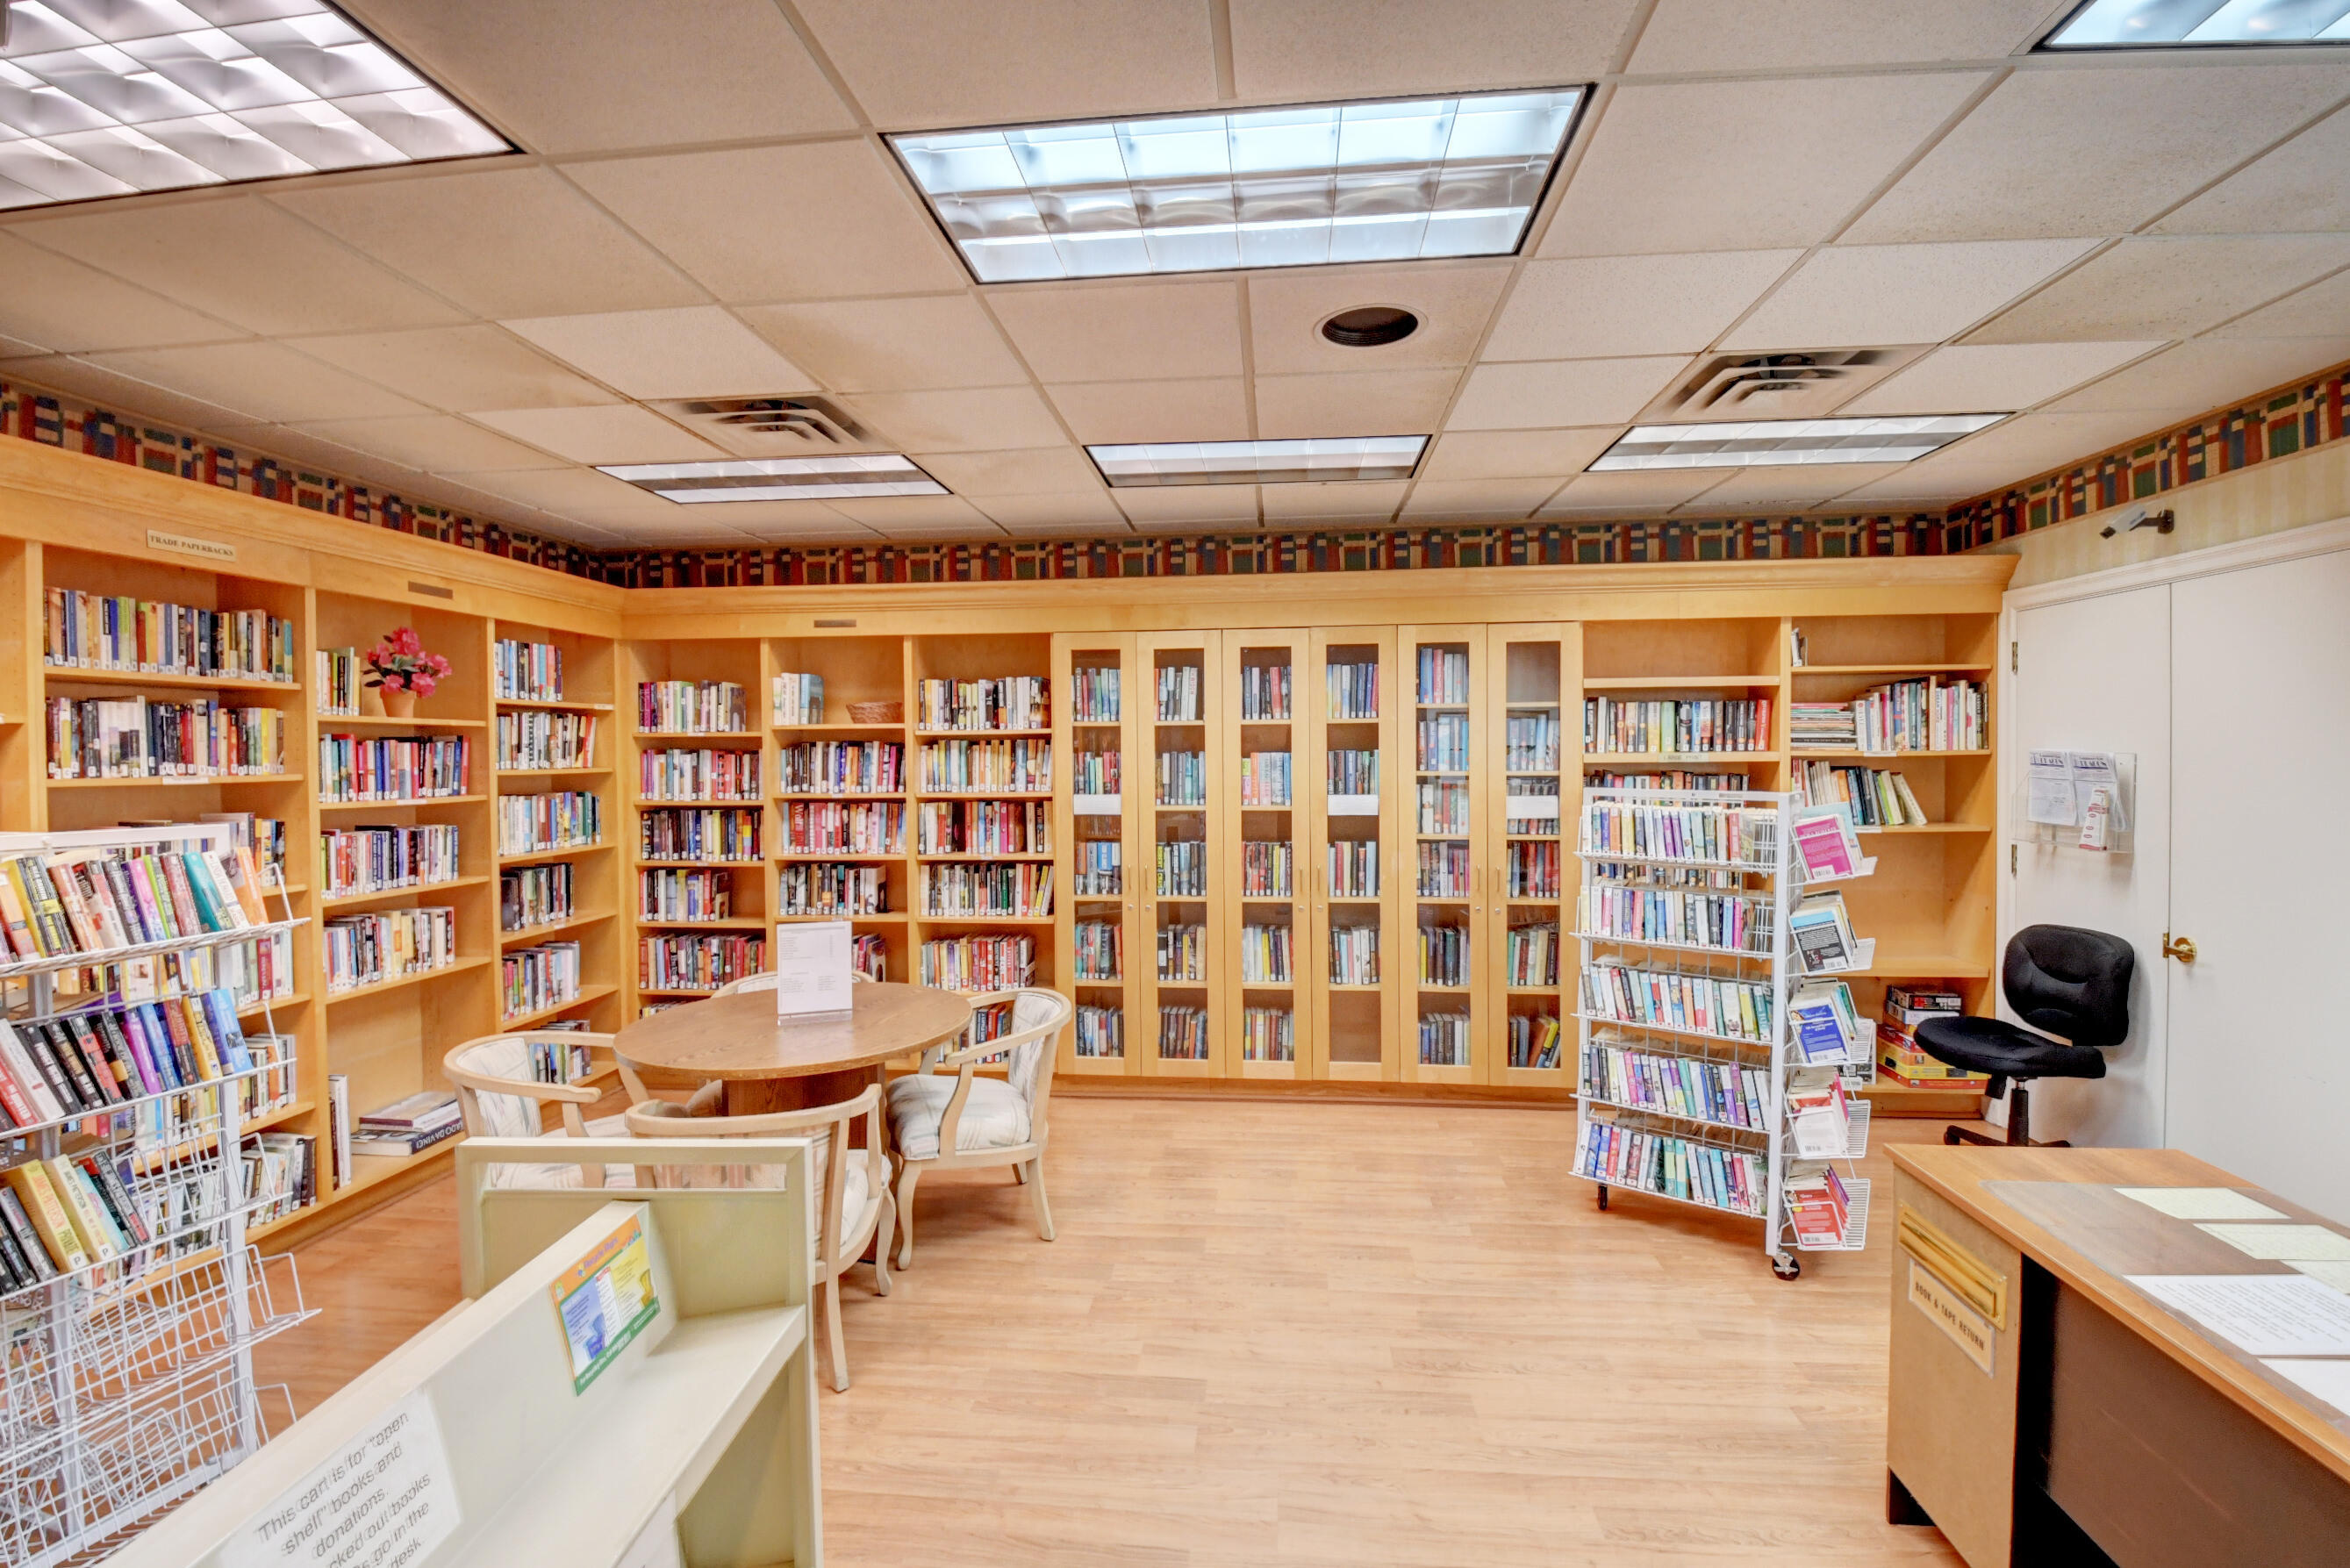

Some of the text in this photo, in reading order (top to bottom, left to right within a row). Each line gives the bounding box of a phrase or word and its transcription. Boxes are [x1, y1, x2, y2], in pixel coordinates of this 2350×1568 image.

[148, 534, 233, 556] TRADE PAPERBACKS
[415, 1134, 436, 1149] VINCI
[1916, 1281, 1931, 1302] BOOK
[1941, 1304, 1956, 1325] TAPE
[1959, 1320, 1985, 1351] RETURN
[254, 1508, 297, 1543] This
[295, 1477, 331, 1511] cart
[328, 1464, 346, 1484] is
[345, 1445, 367, 1469] for
[329, 1469, 375, 1514] books
[376, 1441, 404, 1474] and
[364, 1510, 390, 1542] out
[388, 1473, 432, 1517] books
[372, 1501, 430, 1566] go in the
